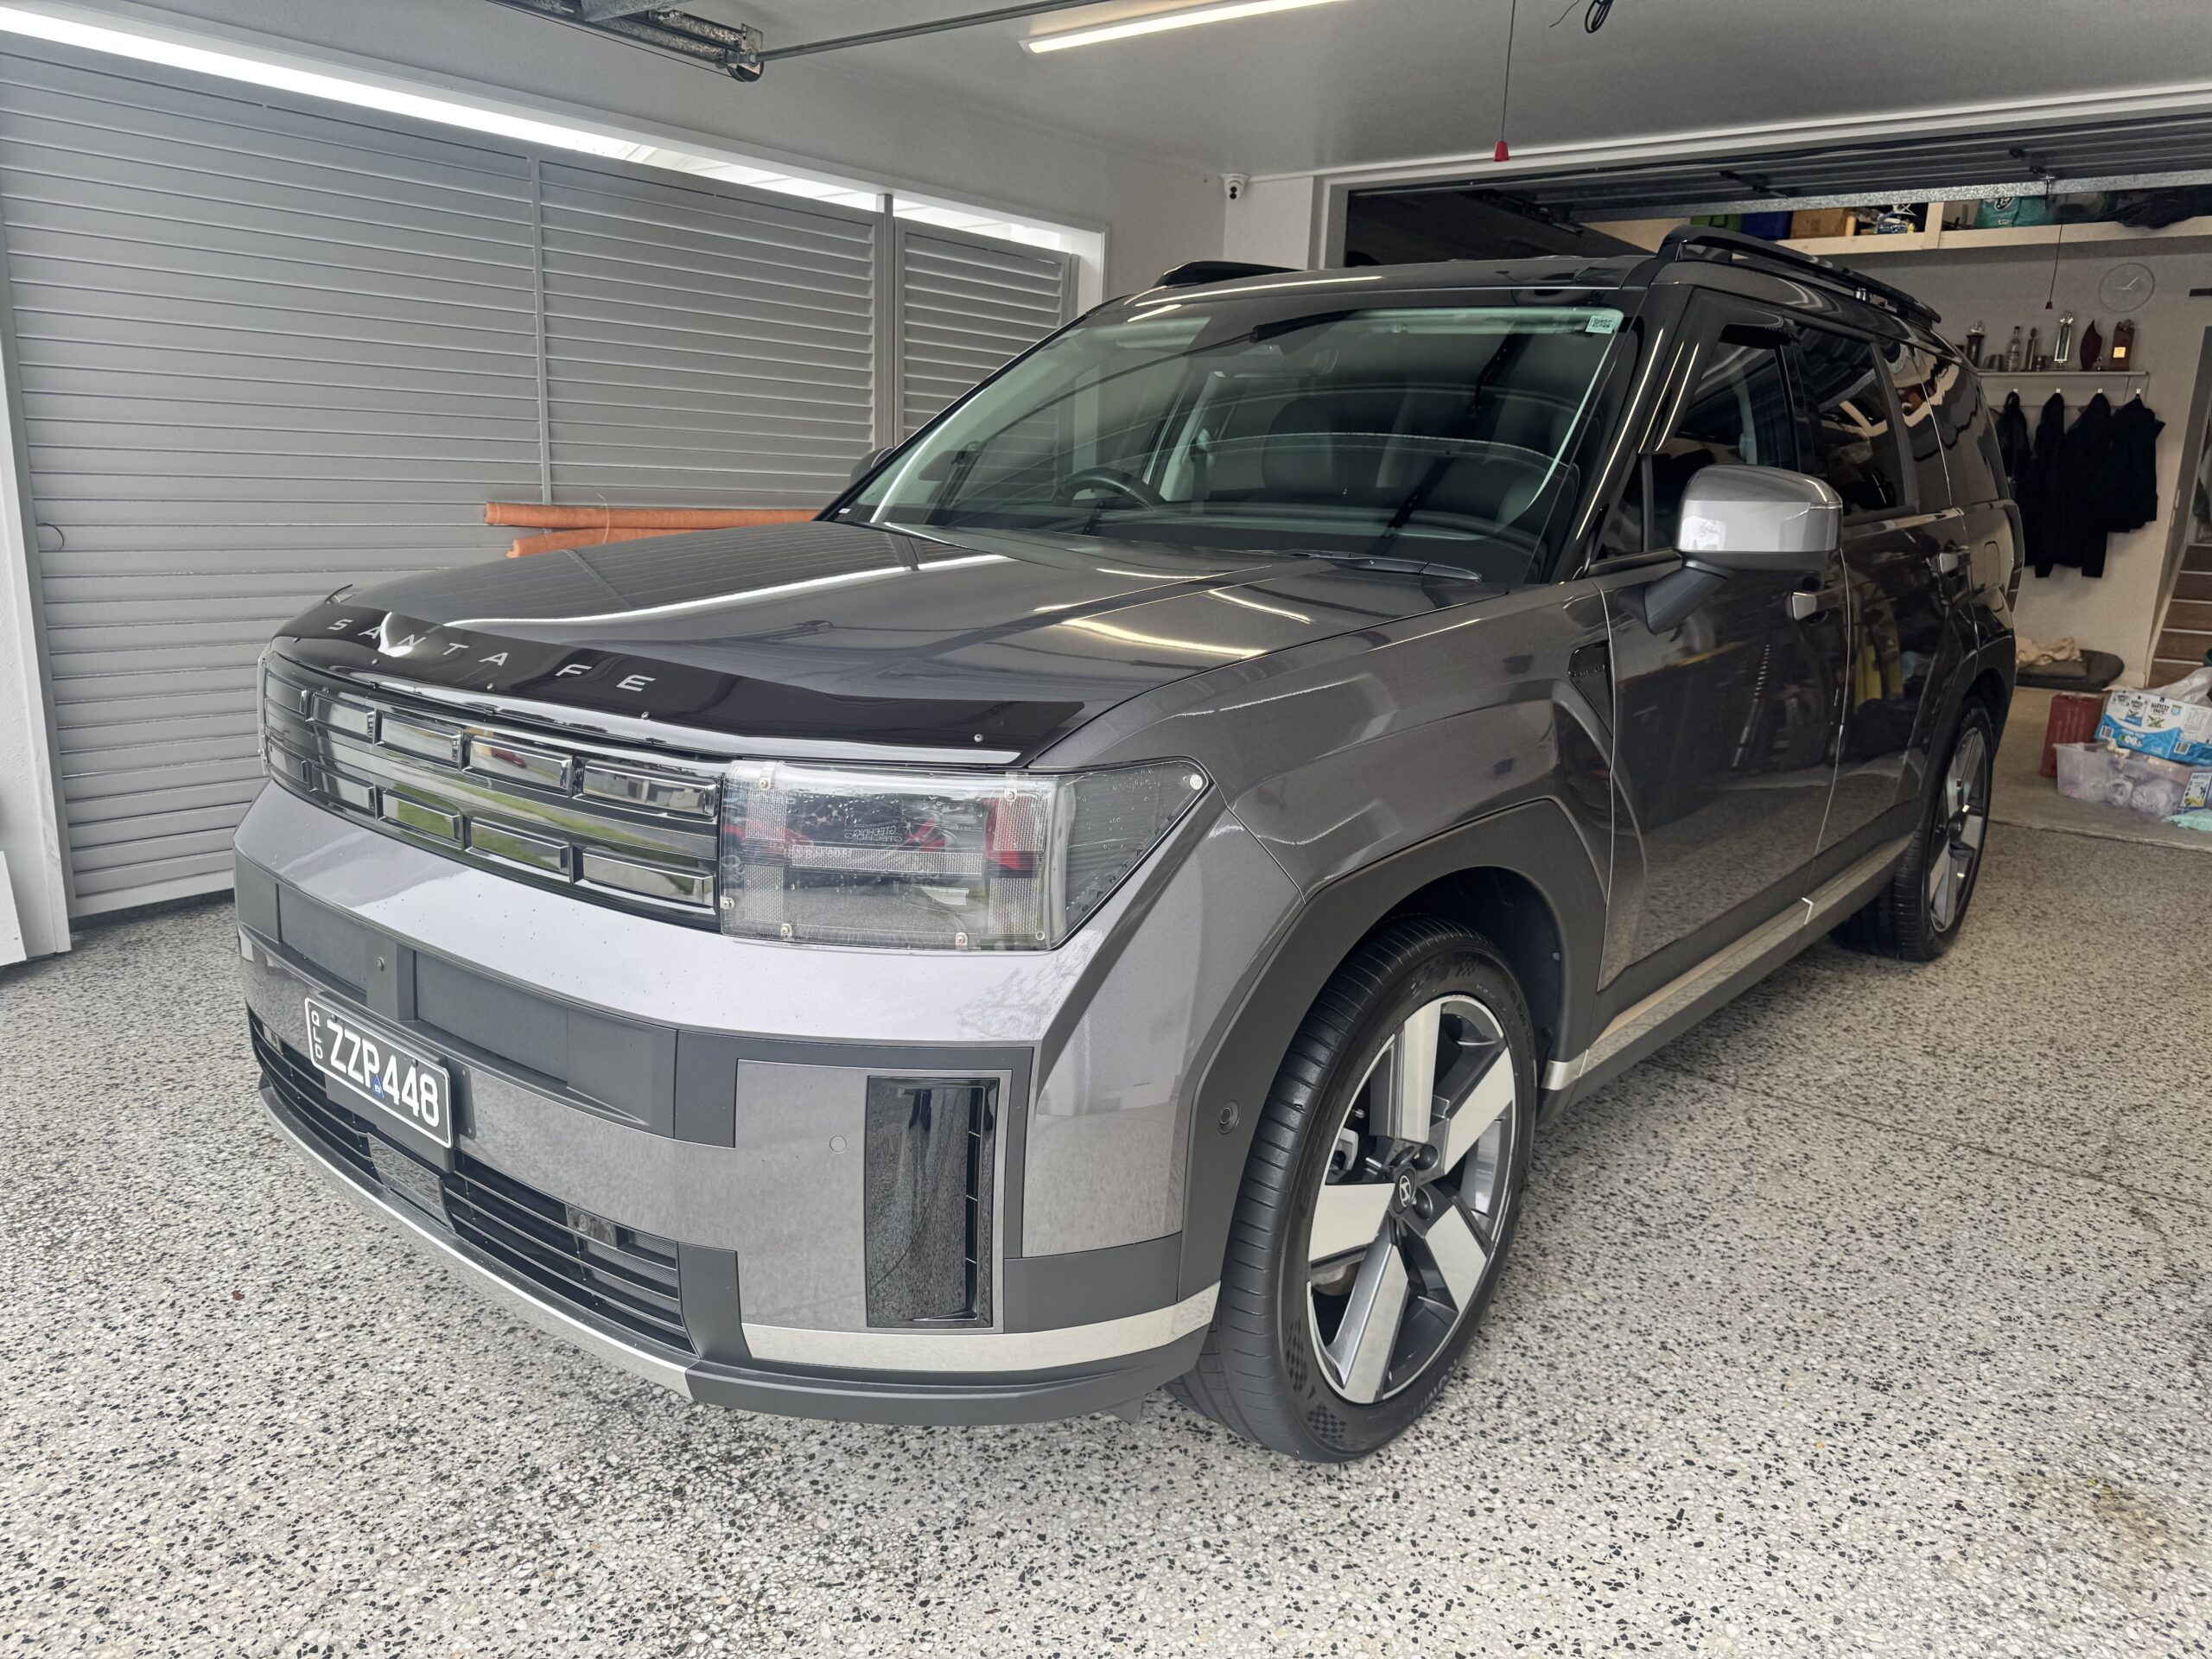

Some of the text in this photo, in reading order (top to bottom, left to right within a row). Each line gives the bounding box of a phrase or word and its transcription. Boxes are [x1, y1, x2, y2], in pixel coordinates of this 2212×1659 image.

[327, 618, 657, 692] SANTA FE
[311, 1010, 323, 1060] QLD
